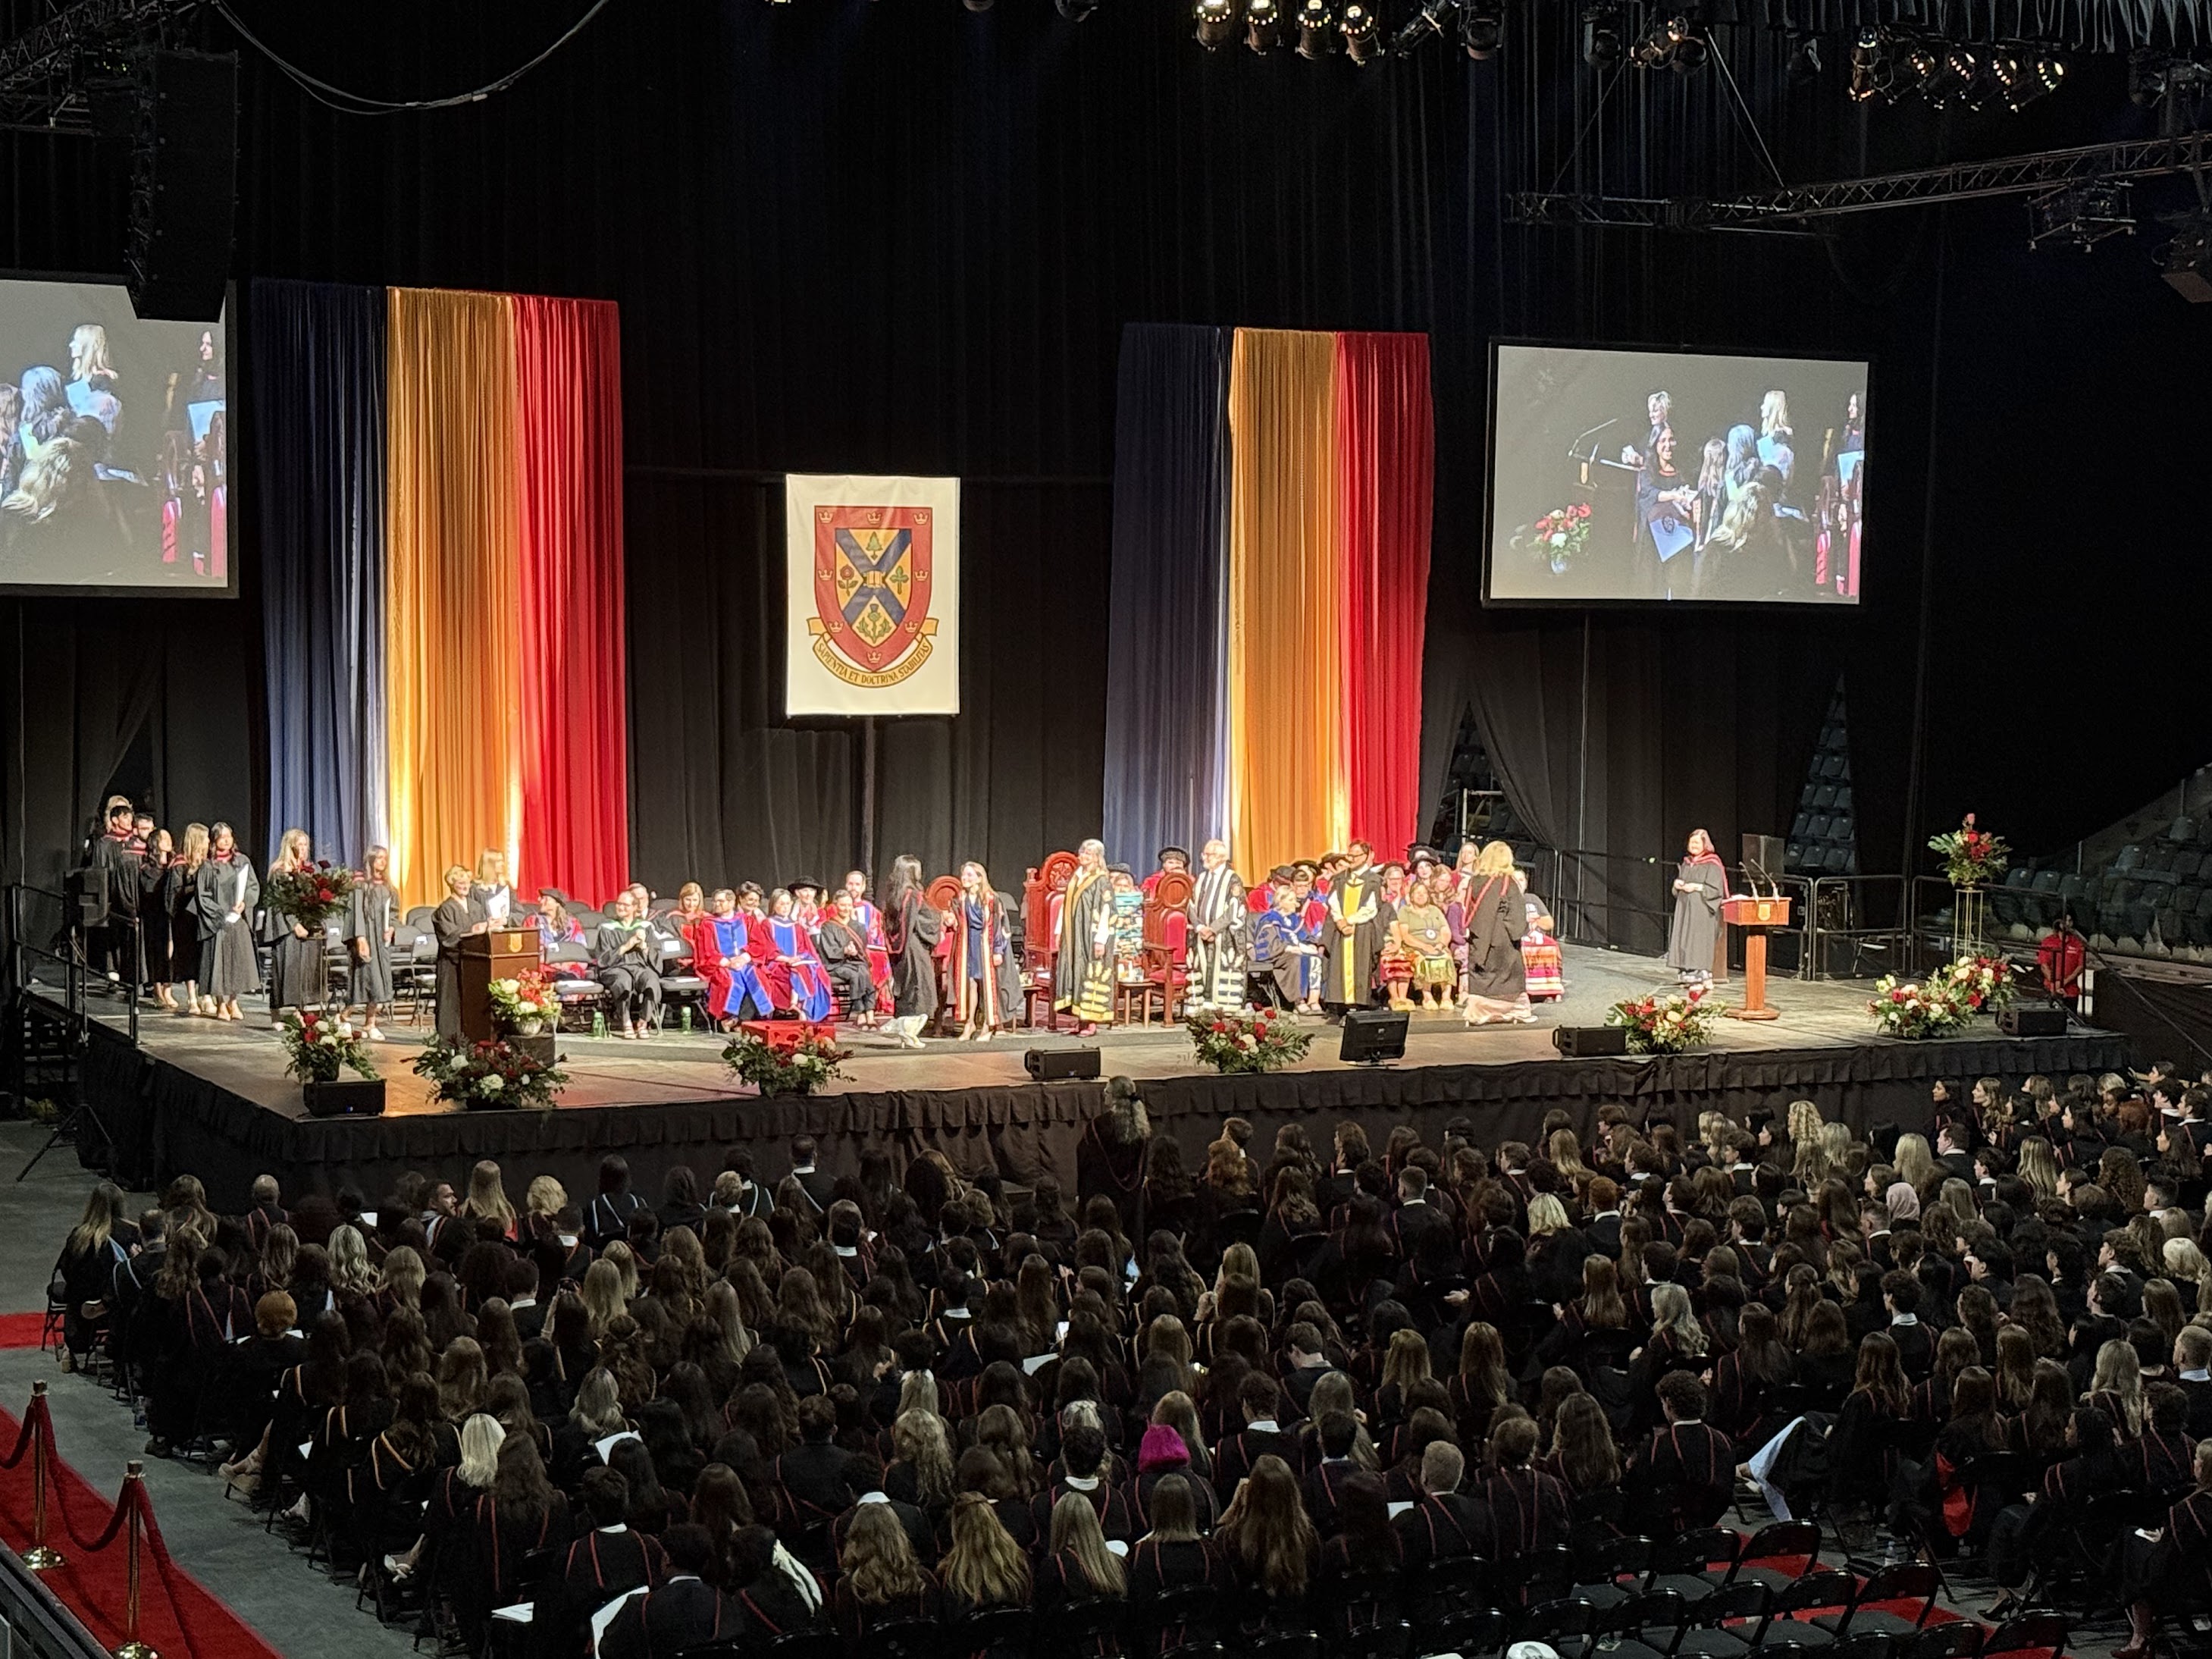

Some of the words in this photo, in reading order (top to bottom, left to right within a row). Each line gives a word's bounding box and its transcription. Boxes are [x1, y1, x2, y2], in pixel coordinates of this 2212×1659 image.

[817, 643, 847, 676] SAPIENTIA
[848, 672, 860, 682] ET
[862, 673, 898, 684] DOCTRINA
